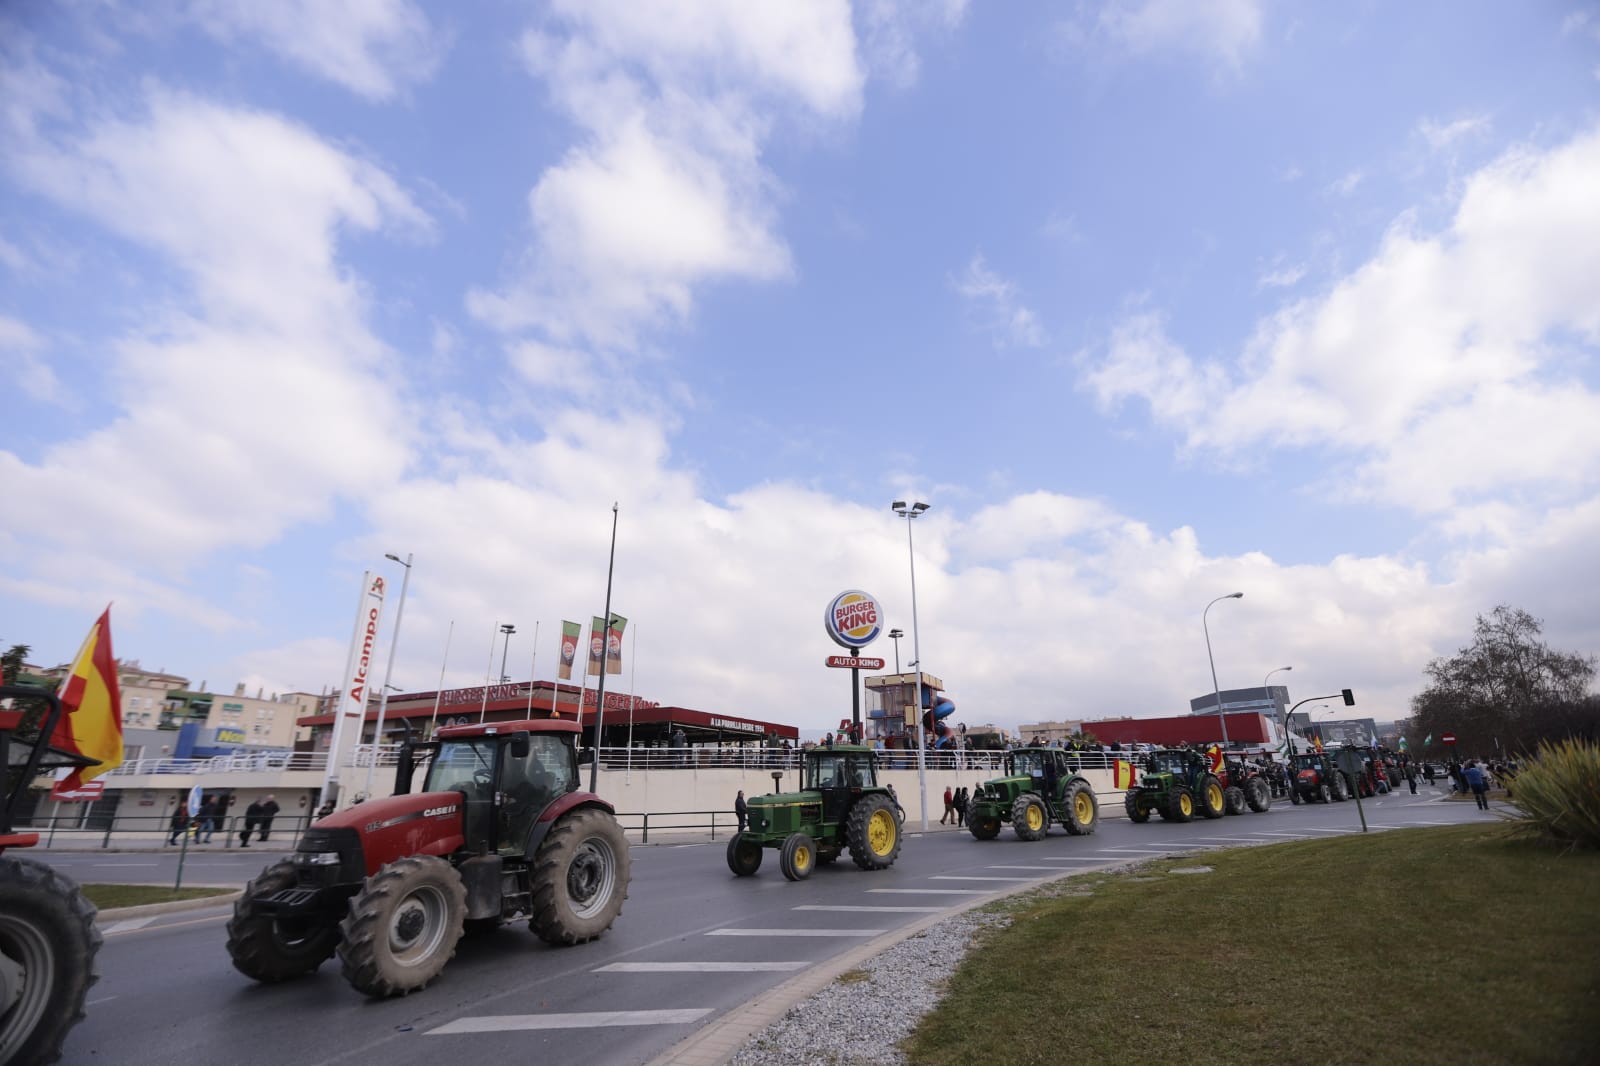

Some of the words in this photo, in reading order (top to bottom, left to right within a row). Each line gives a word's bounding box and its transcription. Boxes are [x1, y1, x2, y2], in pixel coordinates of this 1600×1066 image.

[836, 601, 874, 619] BURGER
[838, 610, 877, 633] KING
[350, 608, 377, 703] Alcampo
[833, 657, 857, 666] AUTO
[858, 658, 880, 667] KING
[486, 684, 519, 700] KING
[423, 806, 448, 817] CASE
